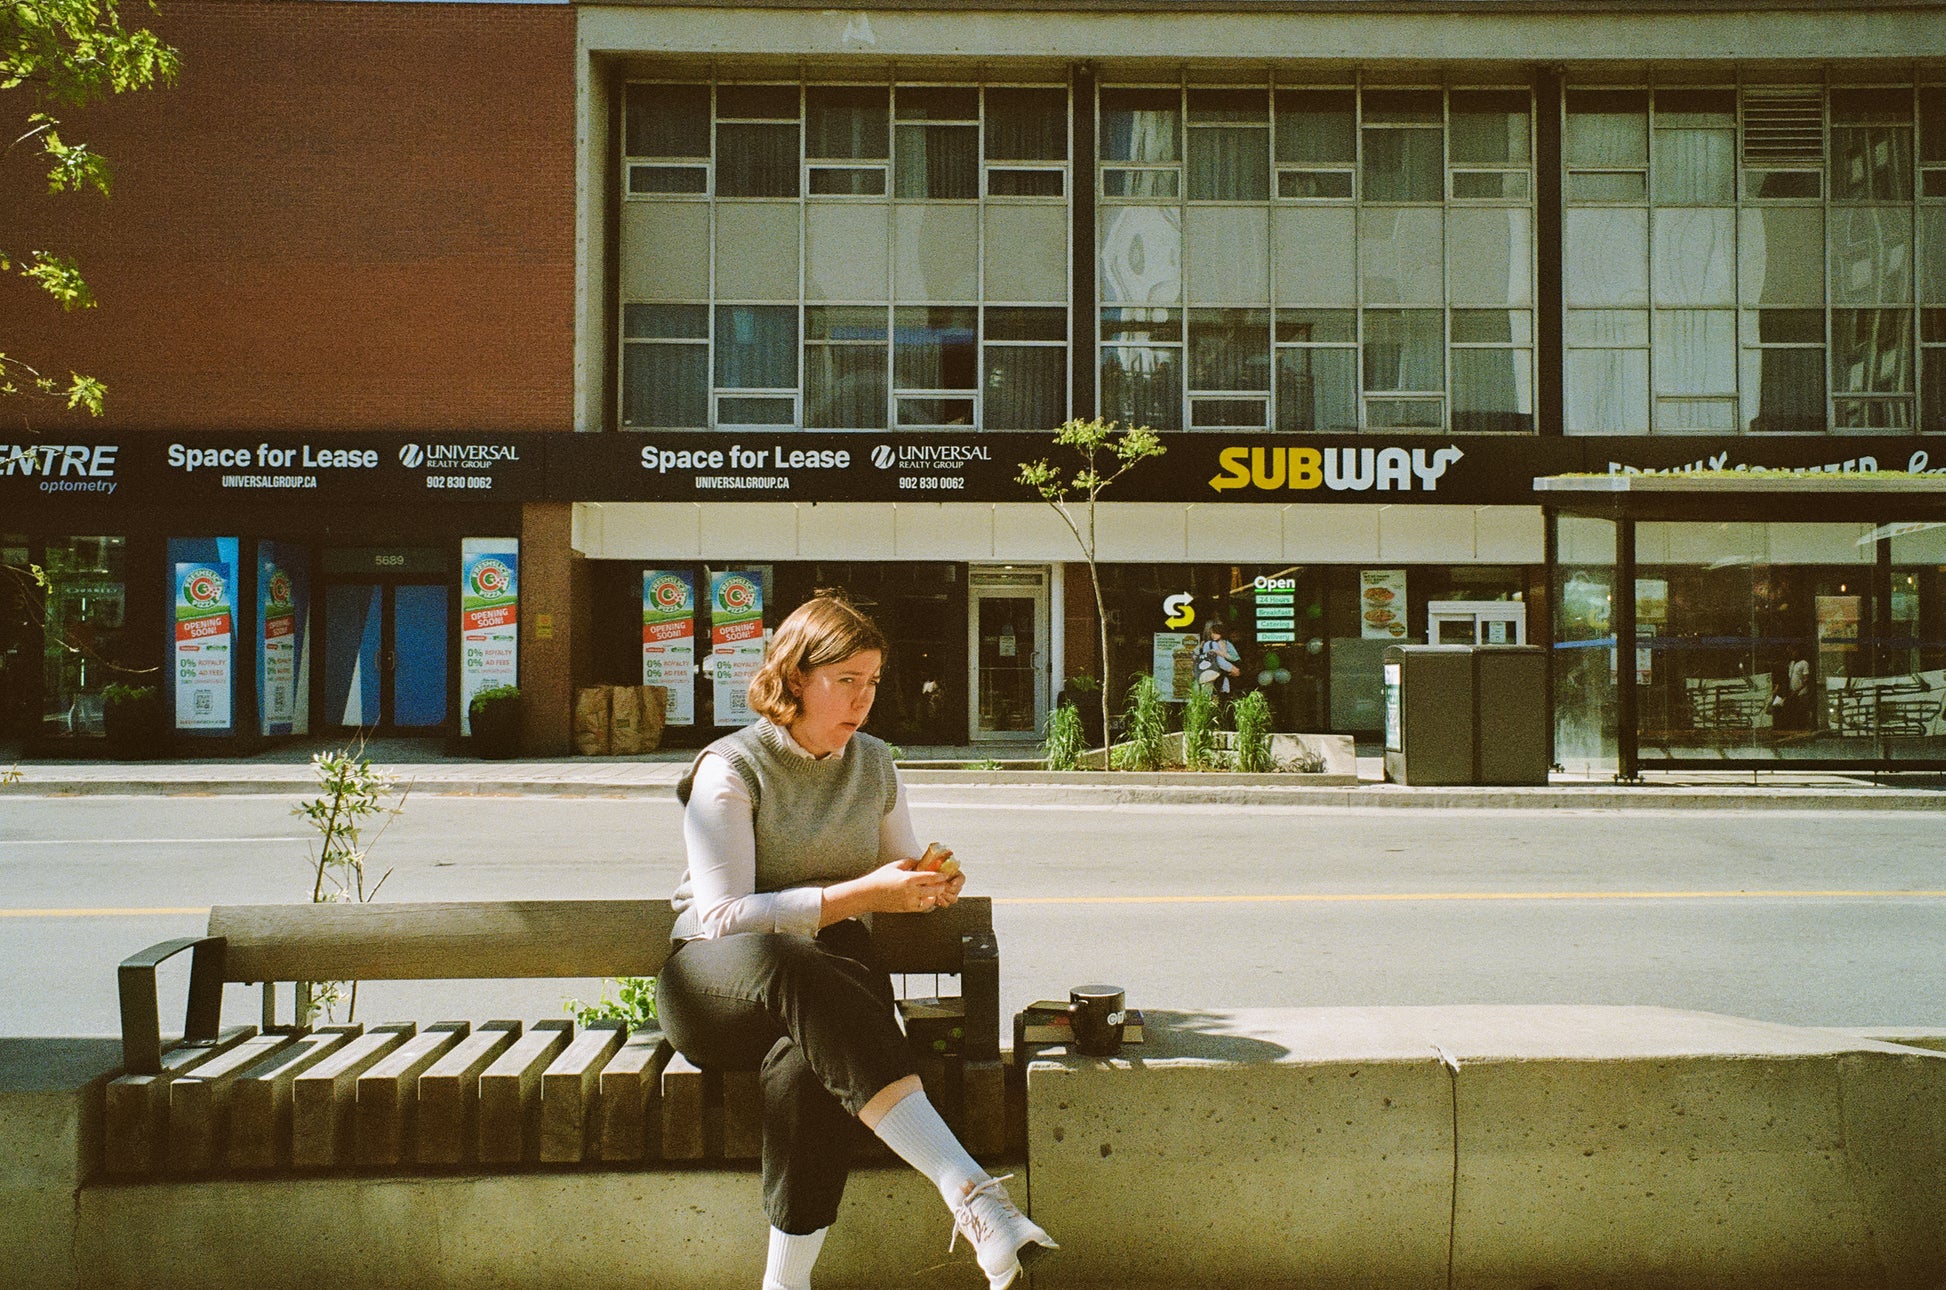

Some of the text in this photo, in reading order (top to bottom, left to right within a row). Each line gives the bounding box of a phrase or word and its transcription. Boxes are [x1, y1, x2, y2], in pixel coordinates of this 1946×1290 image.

[168, 443, 378, 472] Space for Lease
[427, 444, 520, 460] UNIVERSAL
[899, 445, 992, 460] UNIVERSAL
[0, 445, 119, 476] NTRE
[427, 460, 492, 468] REALTY GROUP
[641, 445, 850, 474] Space for Lease
[899, 461, 964, 469] REALTY GROUP
[1208, 444, 1465, 493] SUBWAY
[40, 480, 118, 494] optometry
[222, 475, 317, 488] UNIVERSALGROUP.CA
[426, 476, 492, 489] 902 830 0062
[695, 476, 790, 489] UNIVERSALGROUP.CA
[899, 477, 964, 489] 902 830 0062
[375, 555, 404, 565] 5689
[1254, 576, 1295, 592] Open
[471, 608, 508, 620] OPENING
[184, 618, 222, 631] OPENING
[477, 617, 504, 627] SOON!
[650, 621, 686, 634] OPENING
[191, 626, 217, 637] SOON!
[720, 622, 755, 635] OPENING
[657, 630, 682, 640] SOON!
[725, 631, 750, 641] SOON!
[467, 648, 483, 657] 0%
[180, 659, 197, 668] 0%
[467, 658, 483, 667] 0%
[647, 660, 662, 668] 0%
[716, 661, 732, 669] 0%
[180, 669, 197, 677] 0%
[647, 669, 662, 677] 0%
[716, 671, 732, 679] 0%
